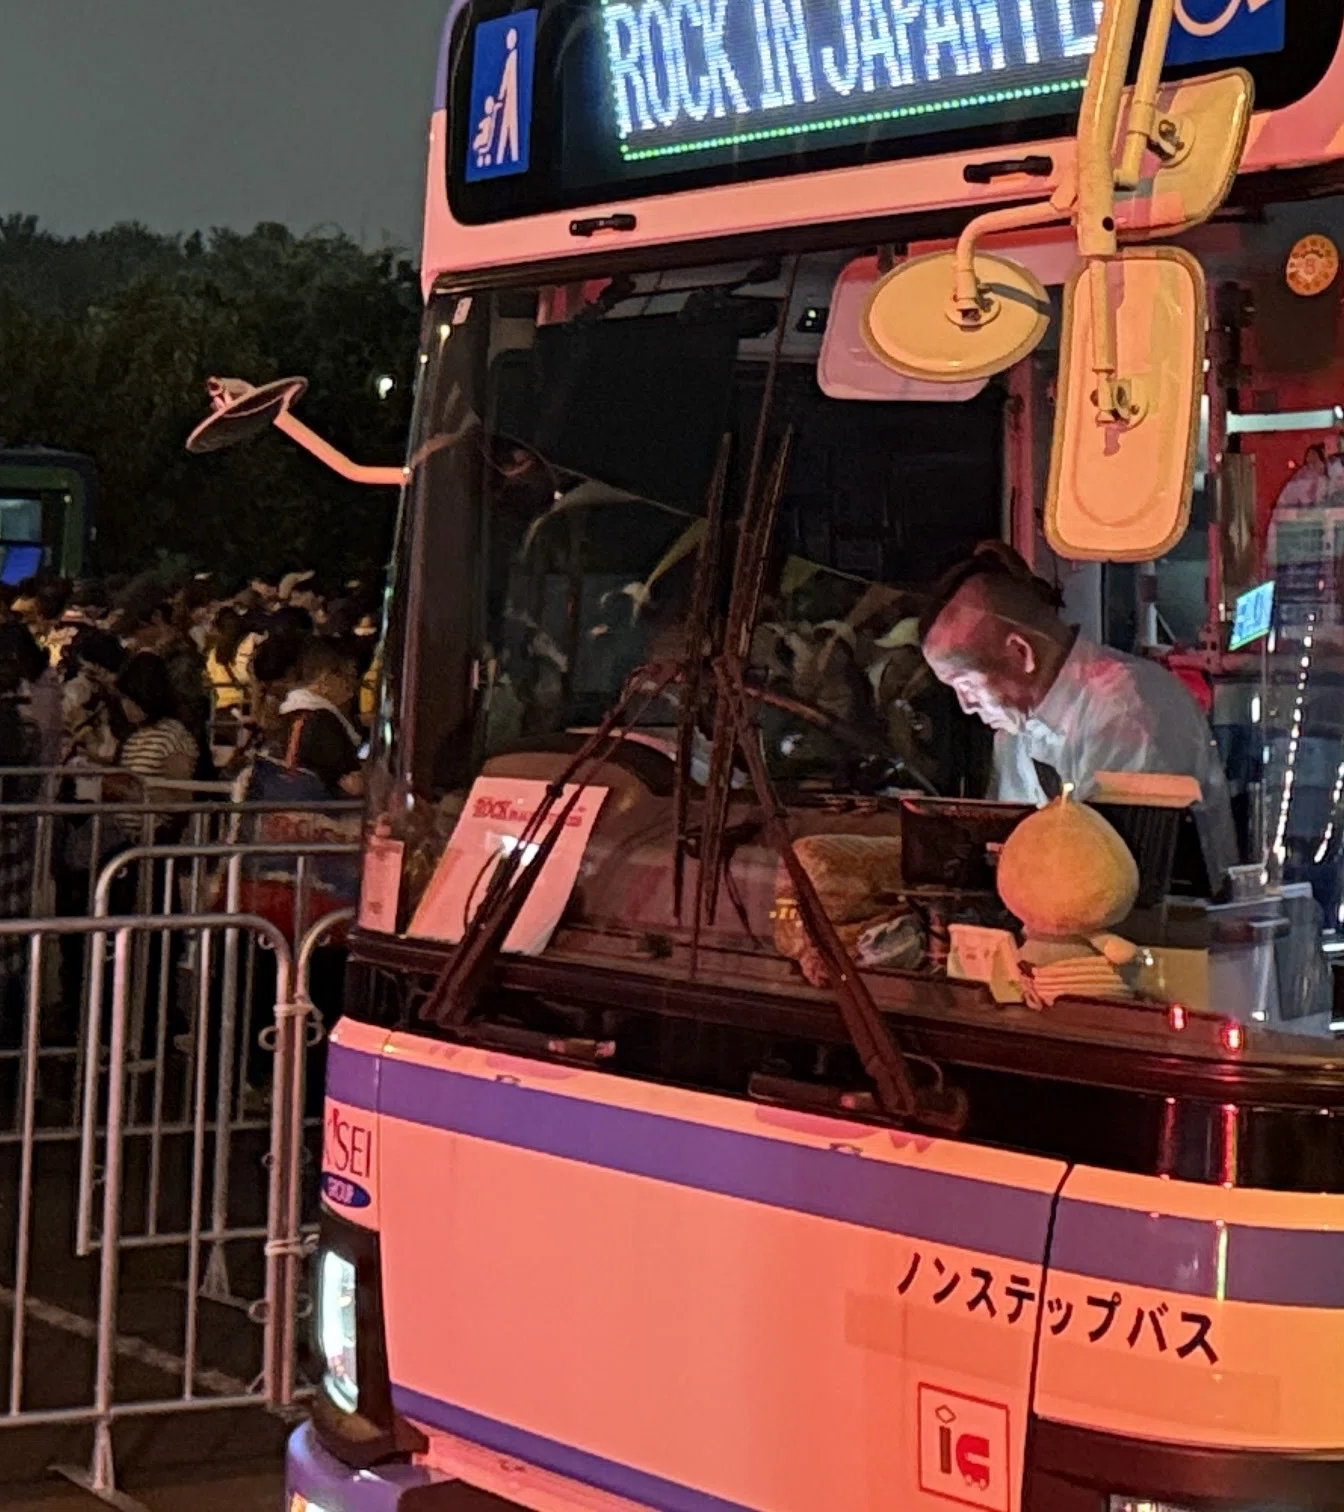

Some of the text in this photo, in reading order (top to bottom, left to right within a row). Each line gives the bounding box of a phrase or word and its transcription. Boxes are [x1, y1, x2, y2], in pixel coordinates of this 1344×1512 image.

[896, 1252, 1219, 1365] ノンステップバス
